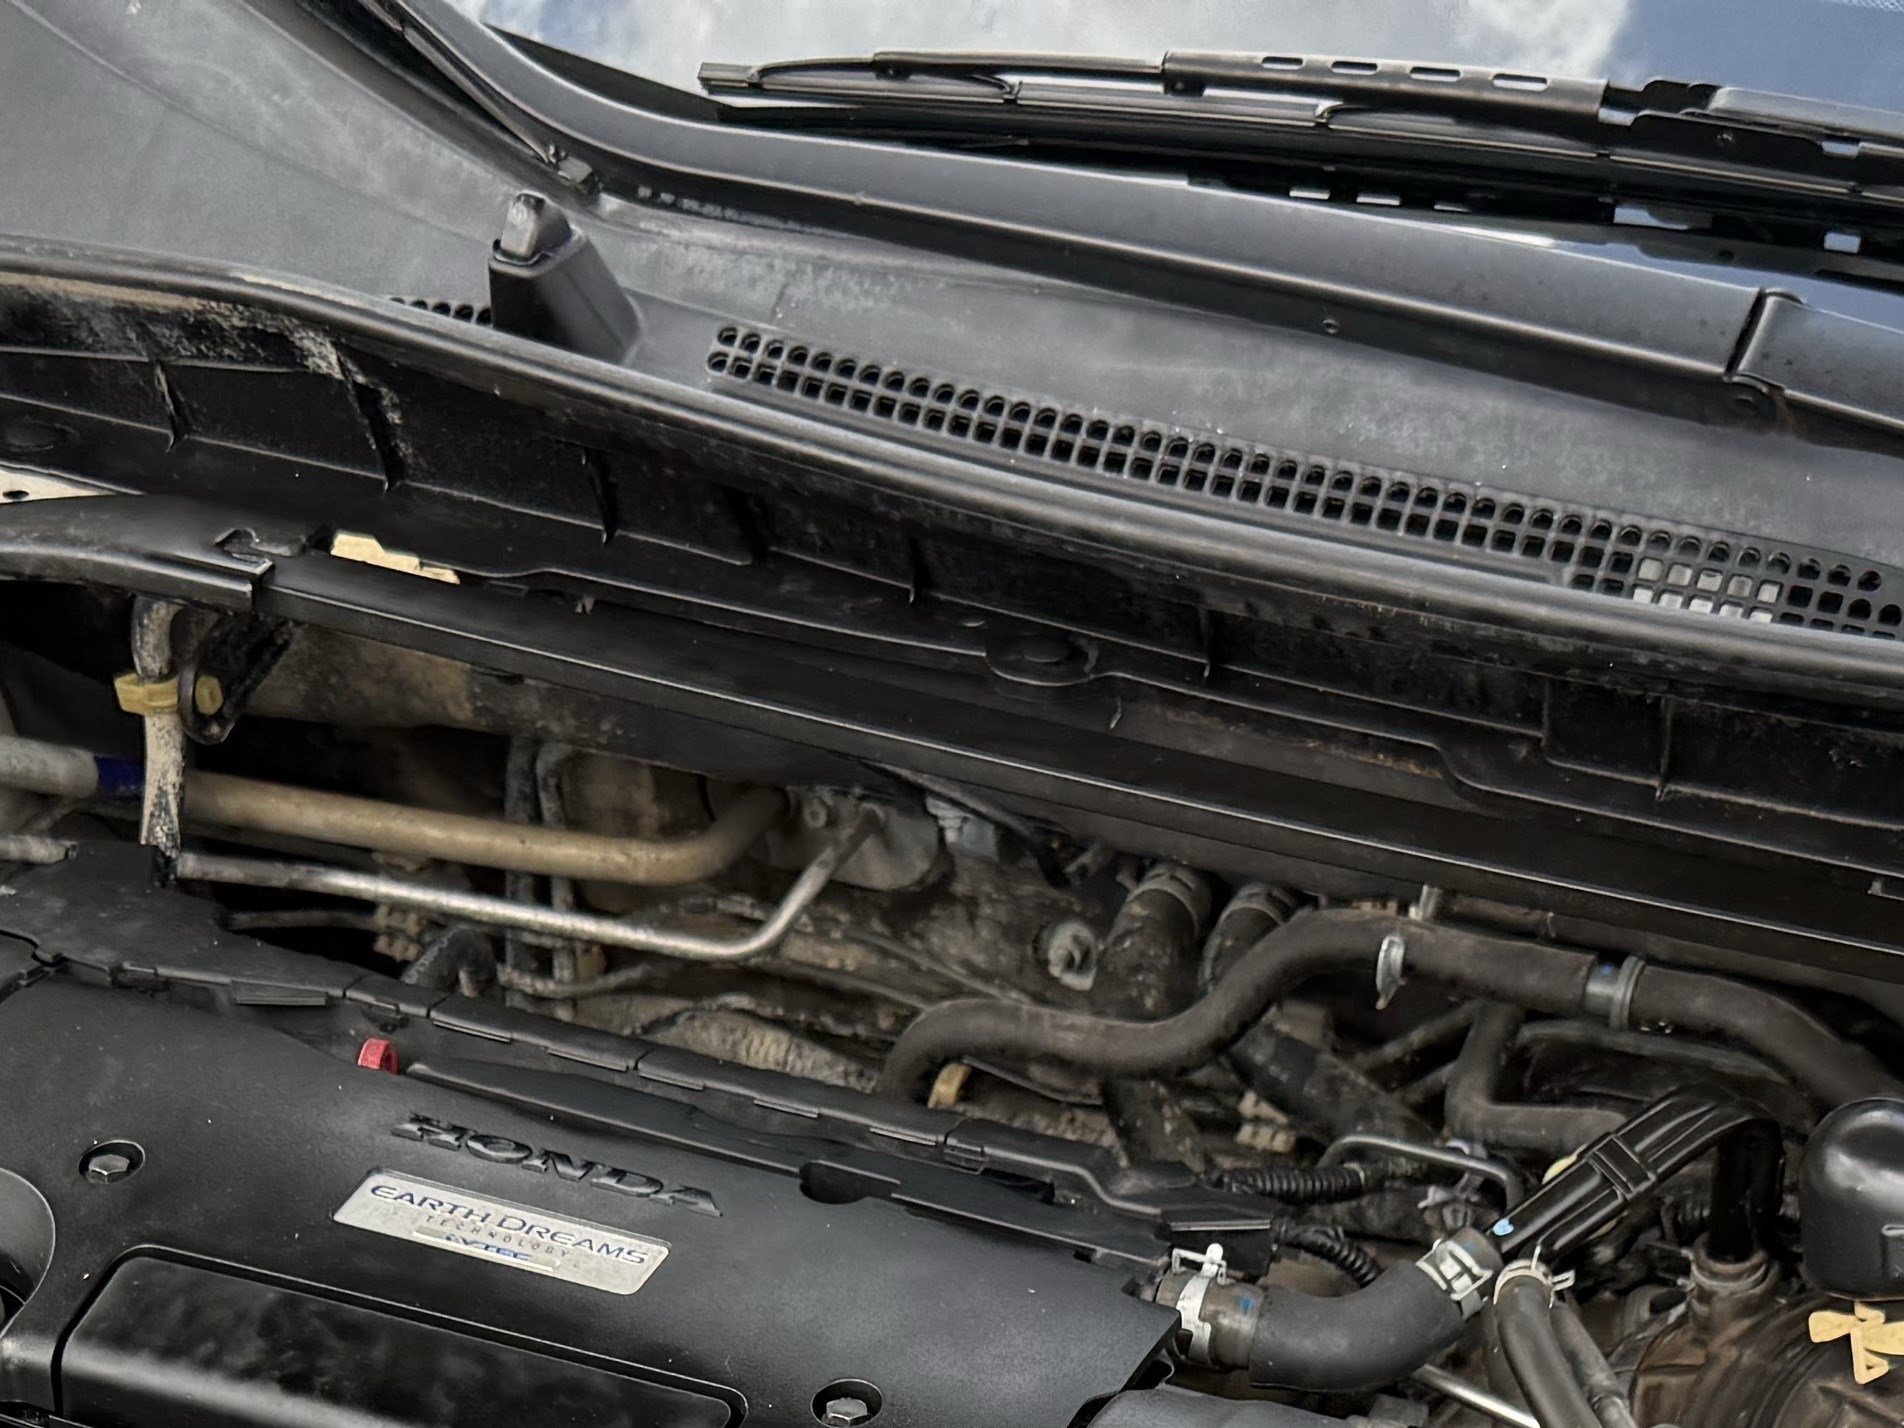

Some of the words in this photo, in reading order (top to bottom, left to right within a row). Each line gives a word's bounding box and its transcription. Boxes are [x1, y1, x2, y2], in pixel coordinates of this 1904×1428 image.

[391, 1112, 723, 1218] HONDA
[370, 1183, 489, 1227] EARTH
[496, 1216, 648, 1265] DREAMS
[426, 1215, 570, 1258] TECHNOLOGY
